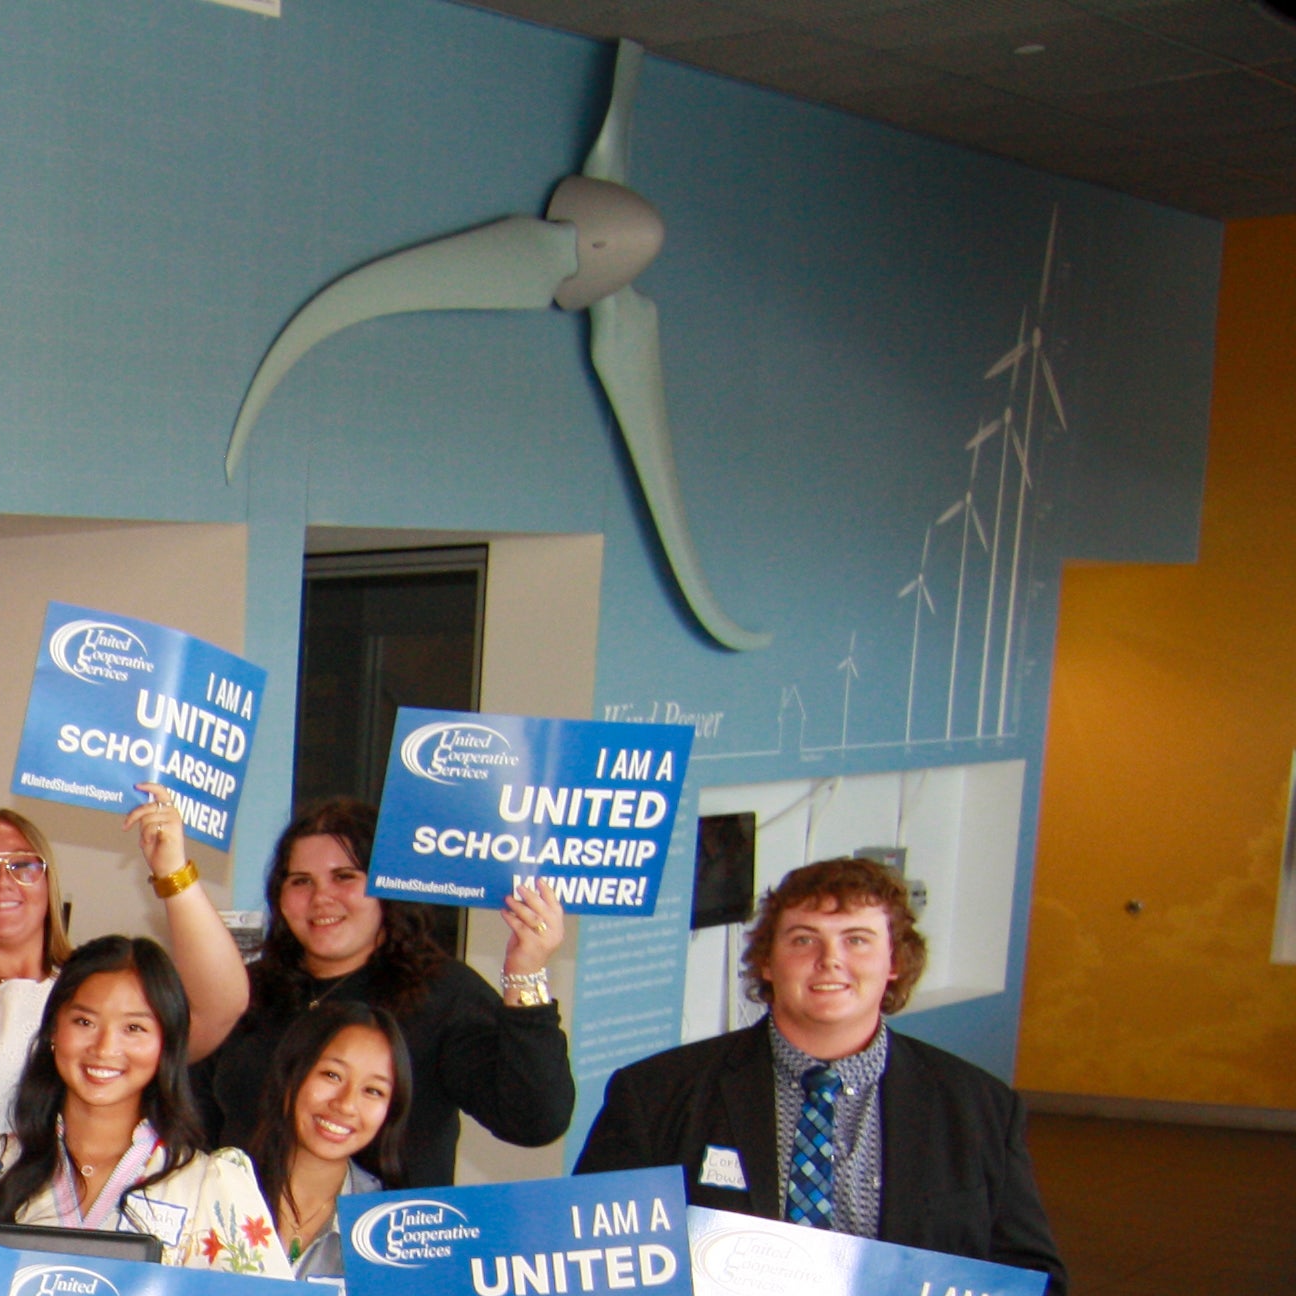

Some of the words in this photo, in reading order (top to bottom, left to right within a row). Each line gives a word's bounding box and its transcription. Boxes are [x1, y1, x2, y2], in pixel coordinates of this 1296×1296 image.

[84, 629, 132, 651] United
[74, 655, 128, 682] Services
[79, 644, 154, 673] Cooperative
[206, 672, 215, 700] I
[216, 678, 241, 713] AM
[241, 690, 252, 720] A
[136, 689, 246, 763] UNITED
[439, 730, 491, 750] United
[58, 724, 236, 800] SCHOLARSHIP
[427, 758, 488, 780] Services
[433, 746, 519, 767] Cooperative
[596, 748, 607, 779] I
[610, 749, 652, 780] AM
[655, 751, 673, 780] A
[21, 772, 123, 803] #UnitedStudentSupport
[149, 788, 227, 839] NNER!
[499, 785, 666, 829] UNITED
[412, 827, 656, 868] SCHOLARSHIP
[375, 875, 485, 899] #UnitedStudentSupport
[388, 1207, 443, 1231] United
[571, 1205, 581, 1238] I
[592, 1200, 639, 1238] AM
[650, 1198, 670, 1231] A
[385, 1240, 451, 1260] Services
[386, 1225, 480, 1247] Cooperative
[40, 1273, 98, 1295] United
